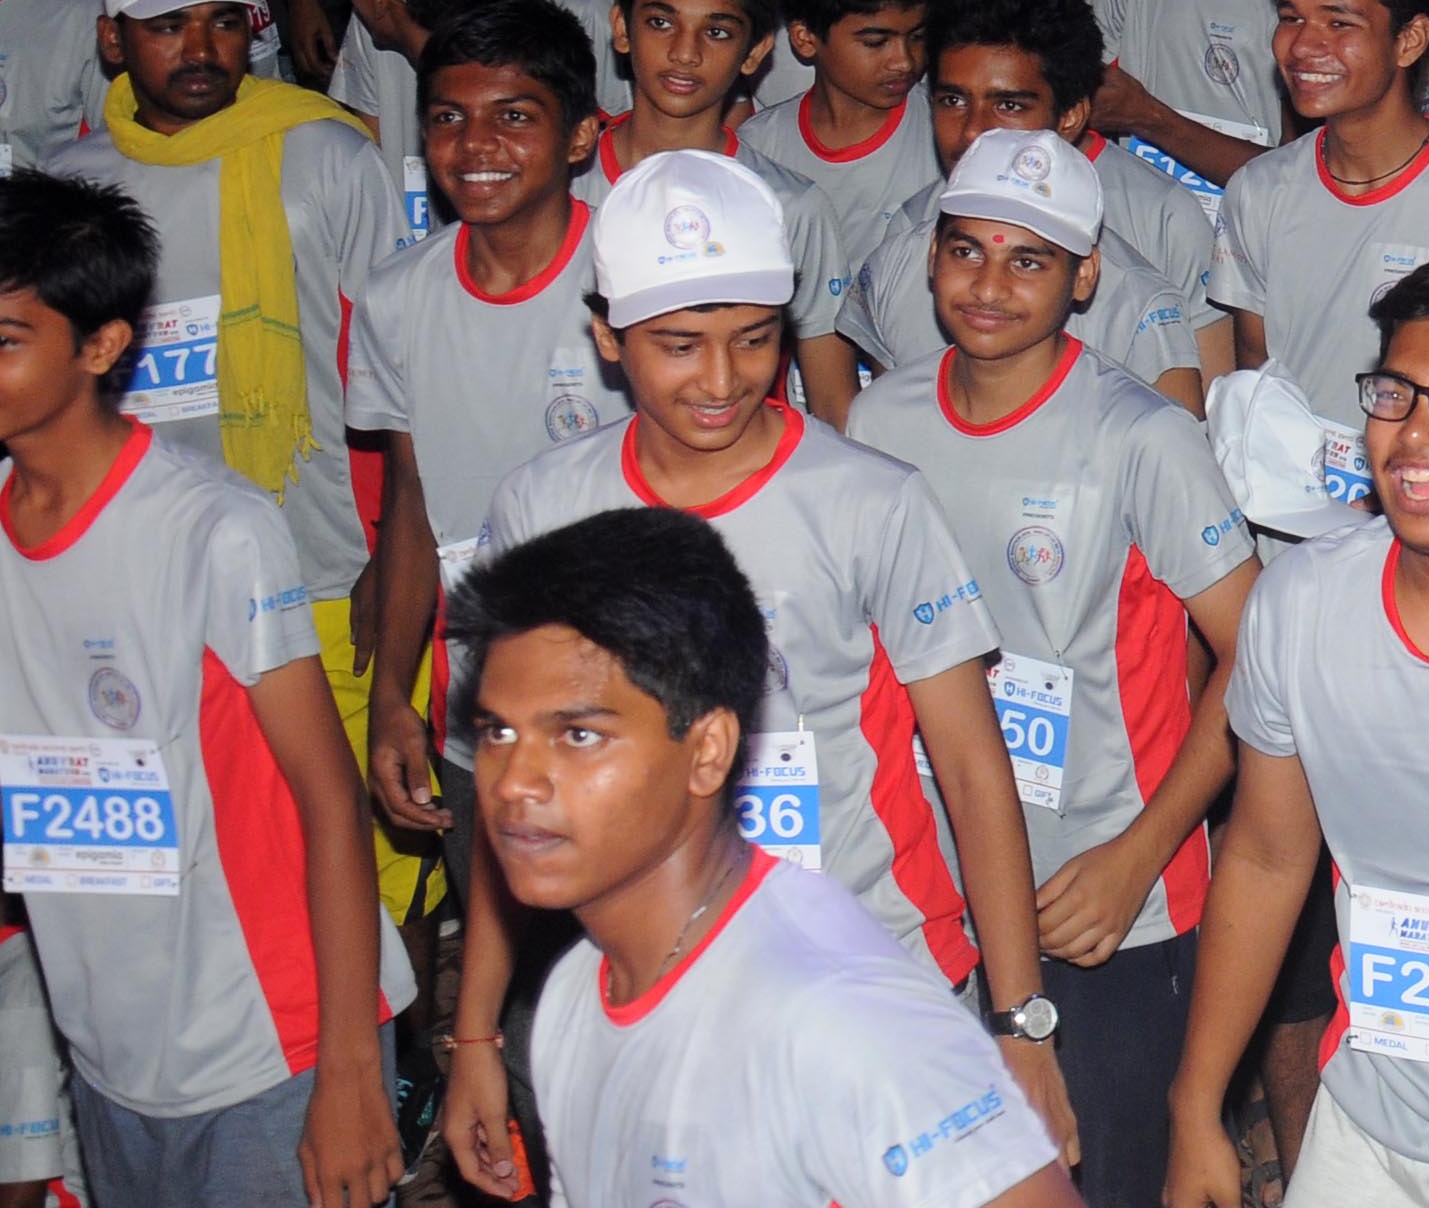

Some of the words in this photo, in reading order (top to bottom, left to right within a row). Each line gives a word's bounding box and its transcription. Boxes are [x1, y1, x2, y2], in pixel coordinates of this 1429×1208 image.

[1016, 686, 1063, 707] HI-FOCUS
[1002, 709, 1056, 757] 50
[111, 769, 159, 783] HI-FOCUS
[10, 793, 165, 842] F2488
[738, 793, 804, 840] 36
[1373, 1036, 1408, 1052] MEDAL
[909, 1089, 1003, 1158] HI-FOCUS
